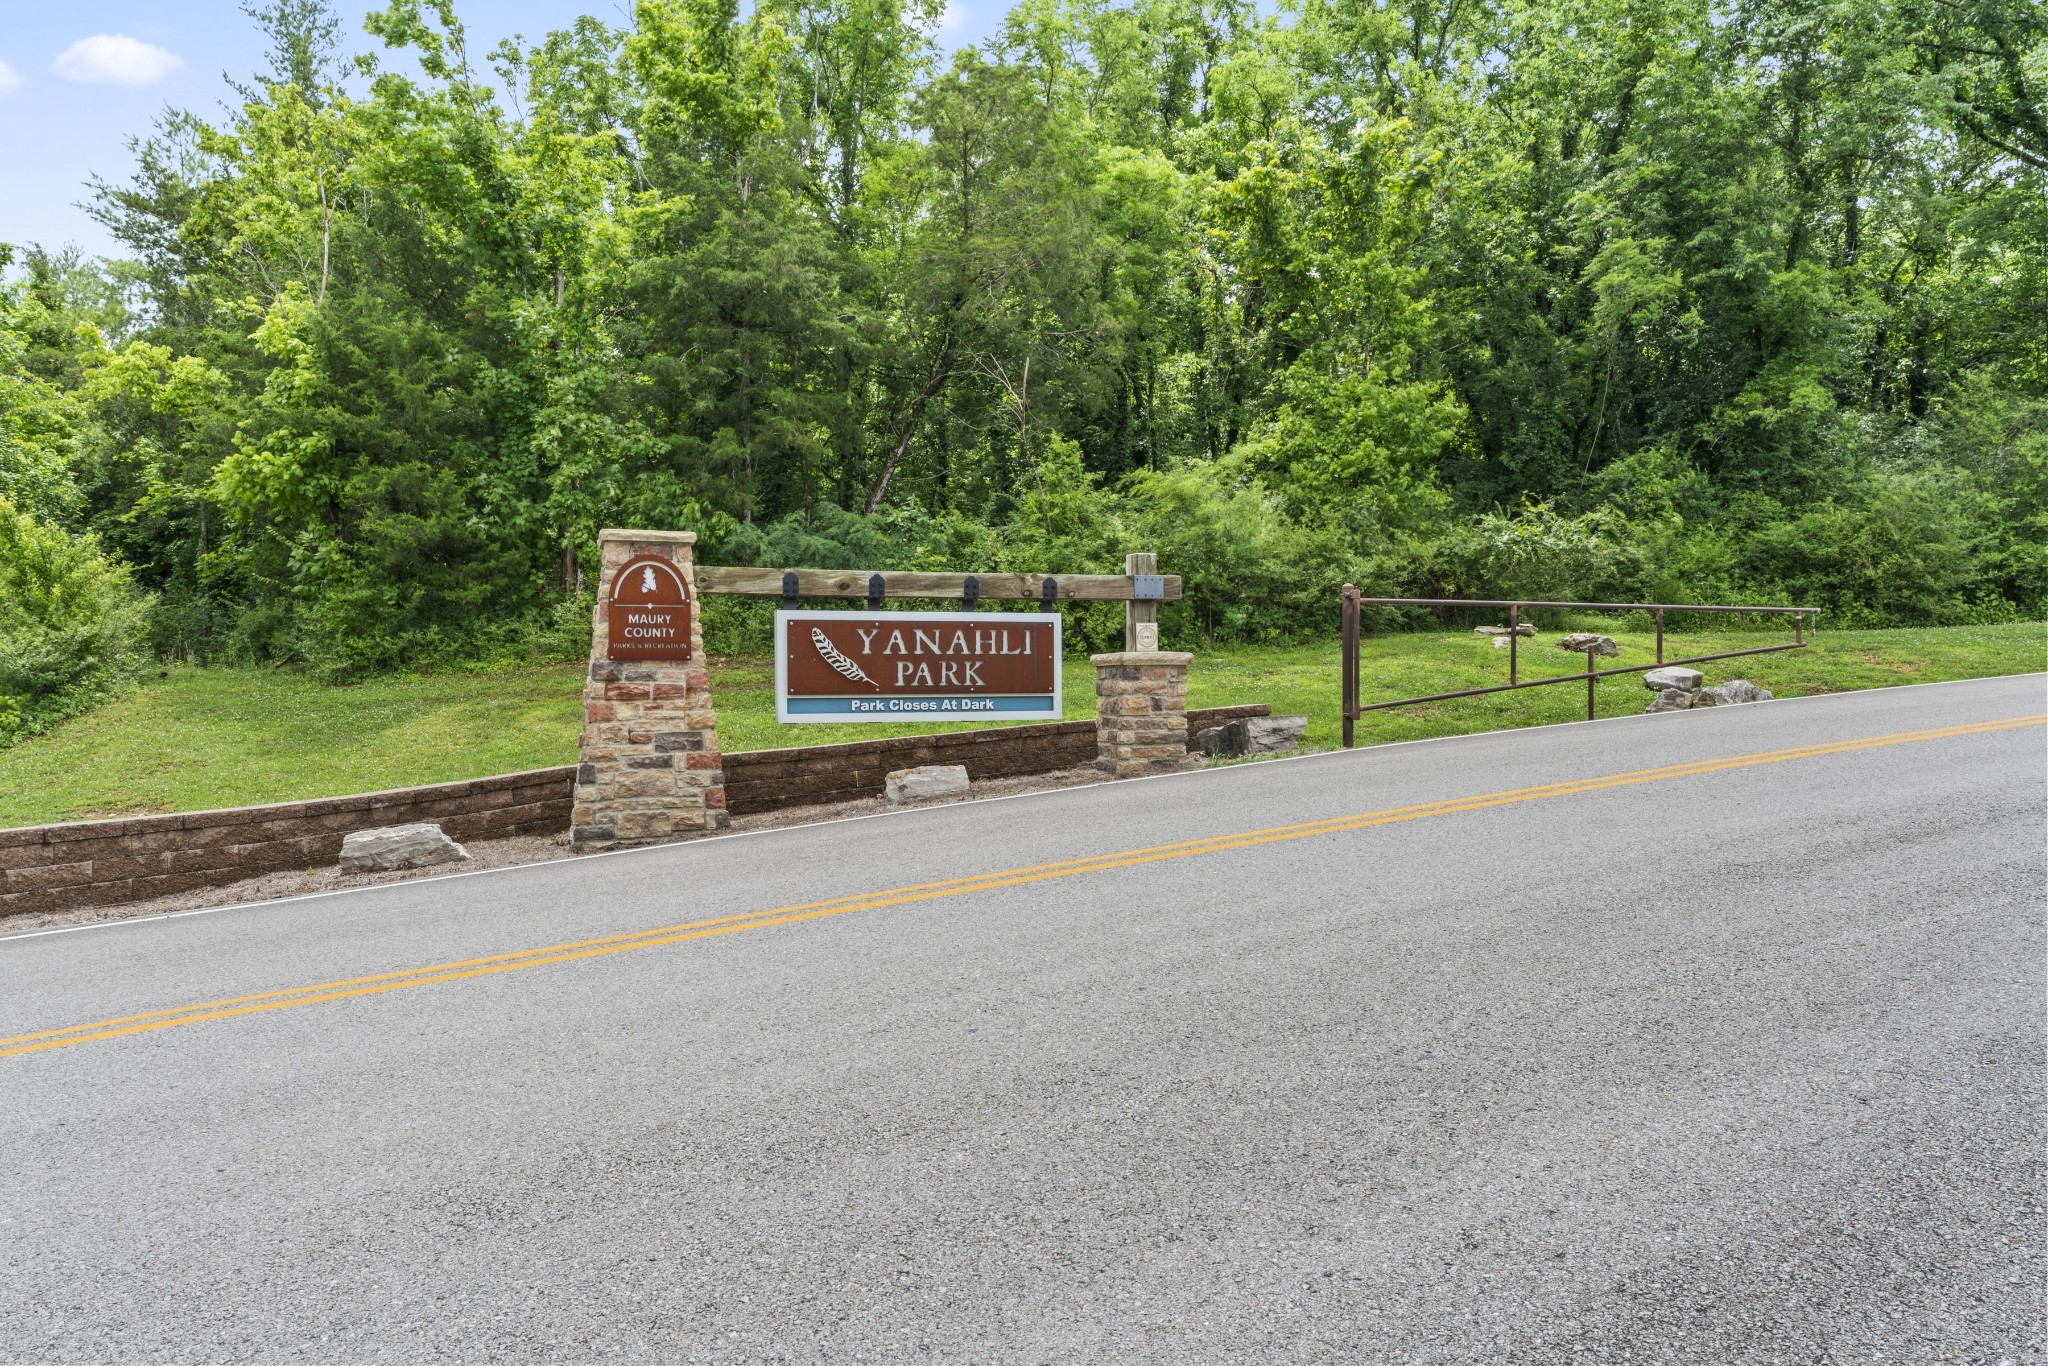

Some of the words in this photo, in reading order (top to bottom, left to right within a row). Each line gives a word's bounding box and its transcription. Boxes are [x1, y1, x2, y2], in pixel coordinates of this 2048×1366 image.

[628, 613, 672, 624] MAURY
[624, 627, 675, 638] COUNTY
[856, 628, 1033, 655] YANAHLI
[894, 660, 987, 687] PARK
[851, 699, 885, 711] Park
[889, 699, 937, 711] Closes
[941, 698, 958, 710] At
[961, 698, 995, 710] Dark
